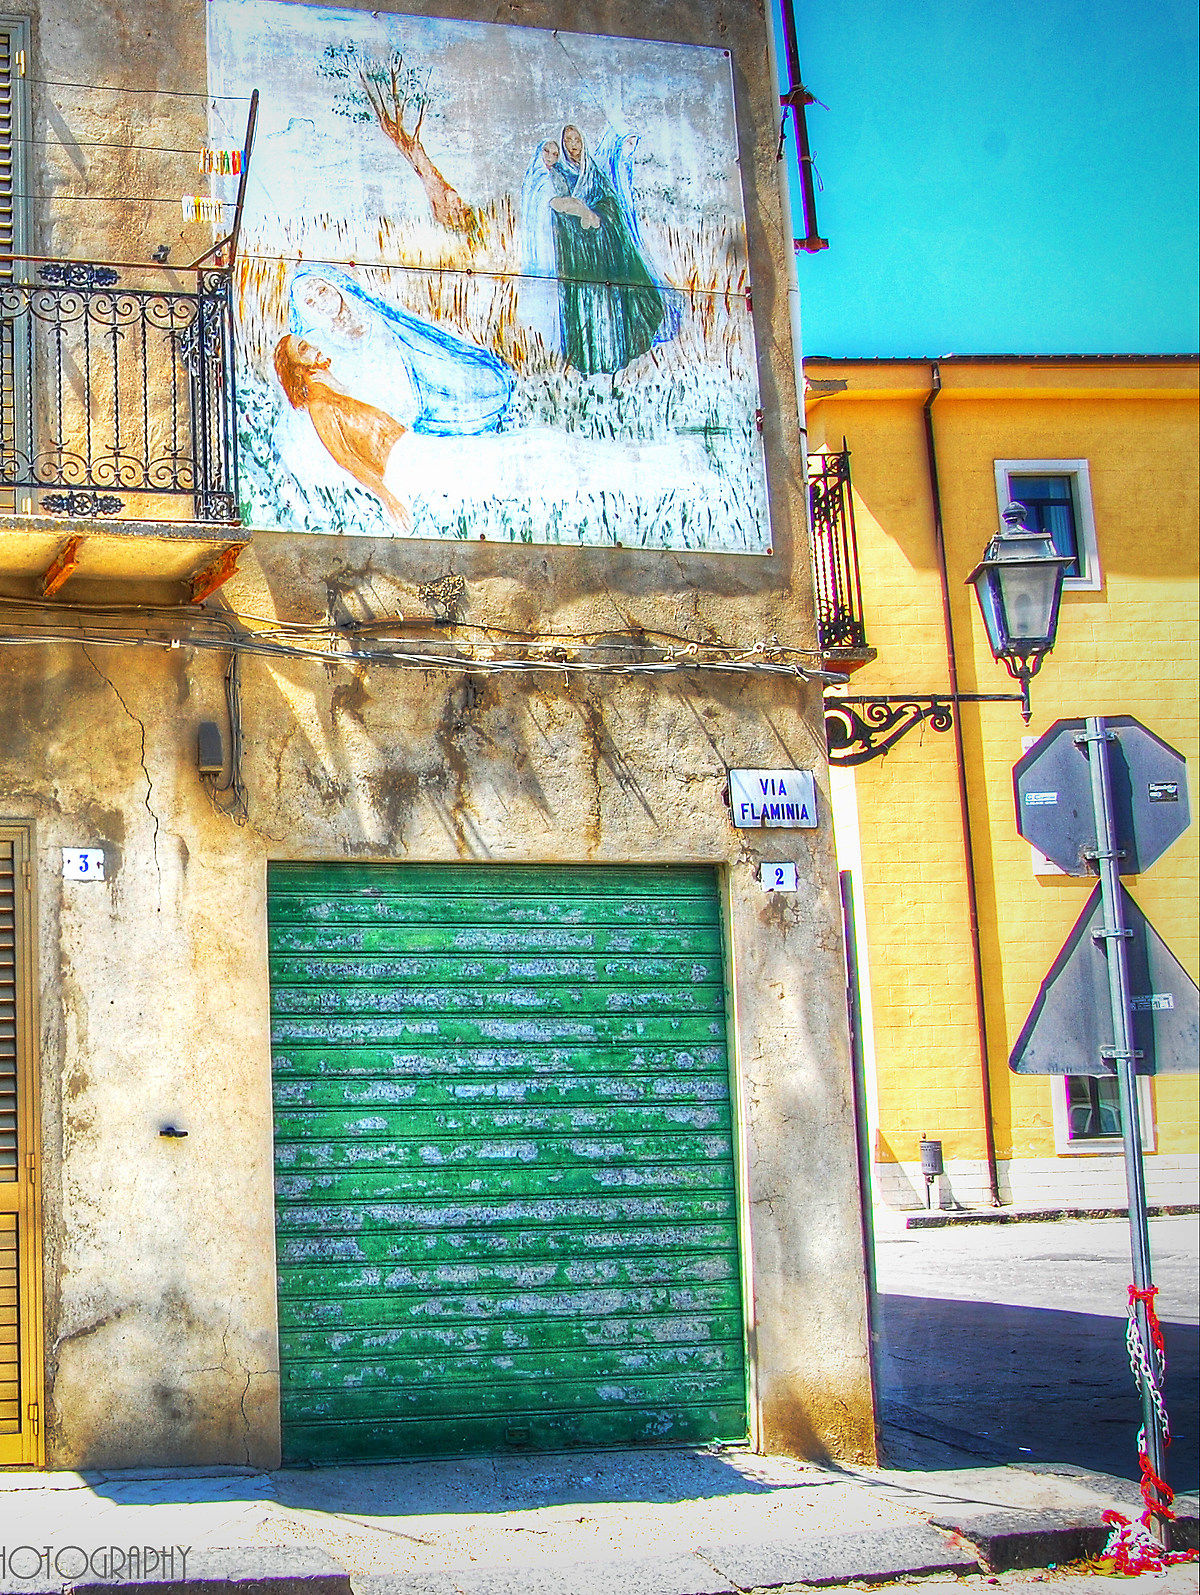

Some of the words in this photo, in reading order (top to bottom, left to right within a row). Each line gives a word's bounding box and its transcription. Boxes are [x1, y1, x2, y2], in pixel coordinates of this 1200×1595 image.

[759, 779, 787, 796] VIA
[740, 803, 809, 820] FLAMINIA
[79, 854, 89, 872] 3
[774, 867, 784, 885] 2
